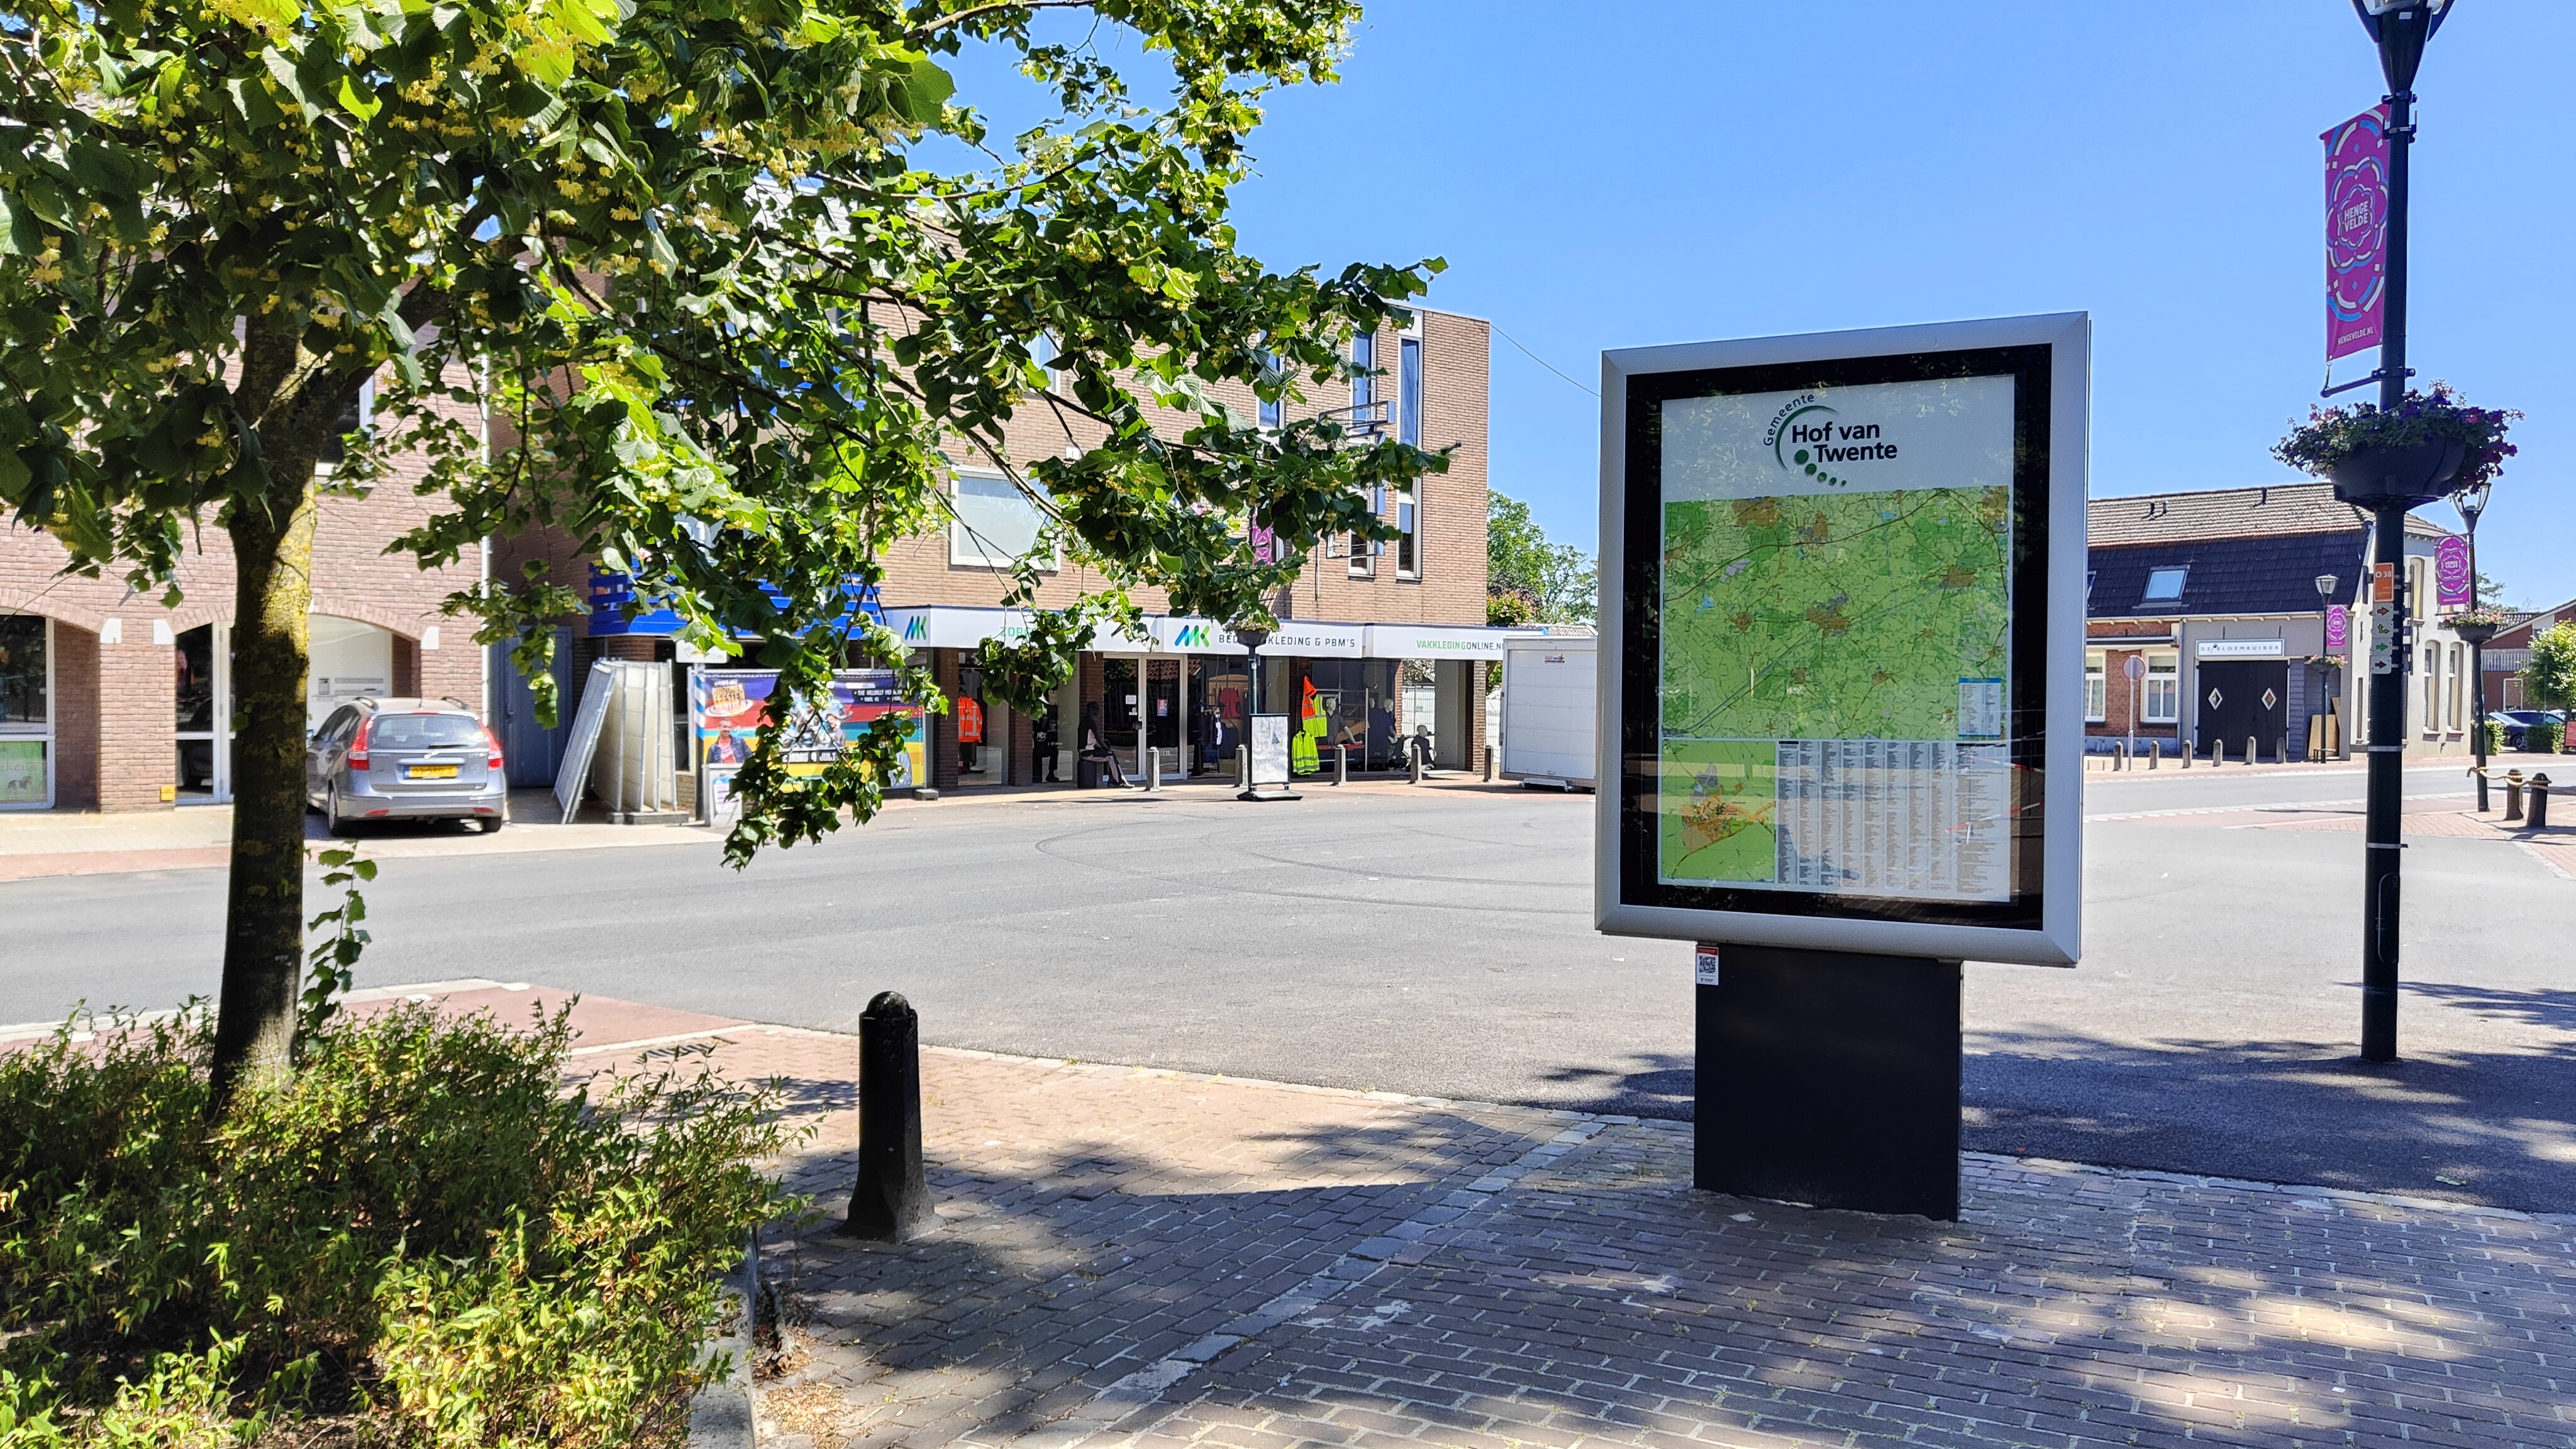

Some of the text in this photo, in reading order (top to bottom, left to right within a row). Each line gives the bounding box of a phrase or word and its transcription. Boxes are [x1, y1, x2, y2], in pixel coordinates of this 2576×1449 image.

[2344, 201, 2368, 221] HENGE
[2344, 213, 2368, 232] VELDE
[2338, 326, 2374, 345] HENGEVELDE.NL
[1763, 394, 1815, 447] Gemeente
[1792, 421, 1880, 443] Hof van
[1813, 441, 1898, 463] Twente
[1314, 637, 1321, 646] &
[1325, 638, 1355, 648] PBM'S
[1416, 640, 1504, 651] VAKKLEDINGONLINE.N
